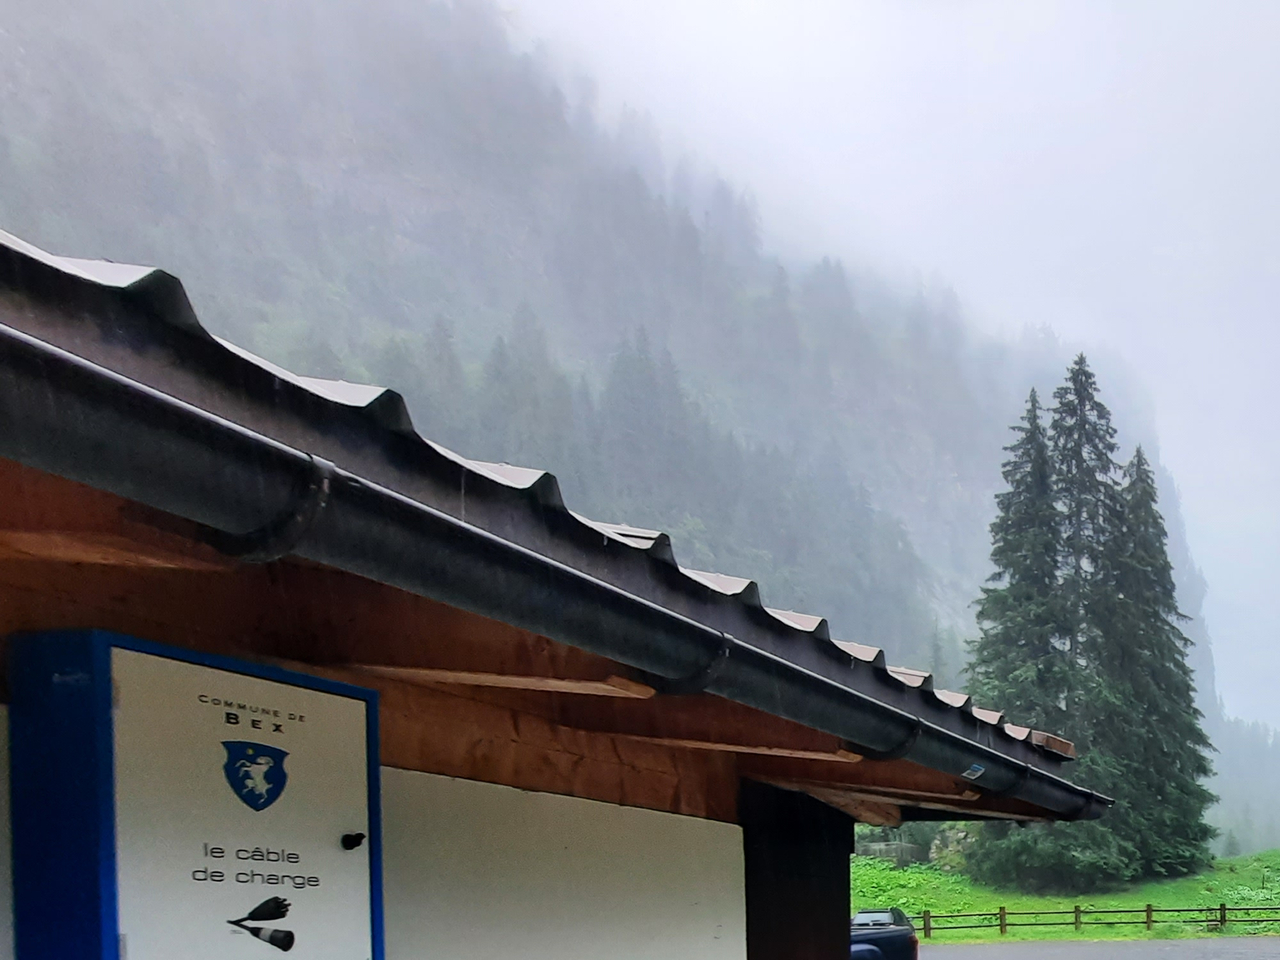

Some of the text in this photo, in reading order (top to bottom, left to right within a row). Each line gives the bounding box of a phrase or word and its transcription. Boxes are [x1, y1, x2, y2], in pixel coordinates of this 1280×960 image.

[198, 694, 306, 722] COMMUNE DE
[225, 711, 285, 734] BEX
[204, 843, 300, 864] le câble
[192, 867, 320, 889] de charge
